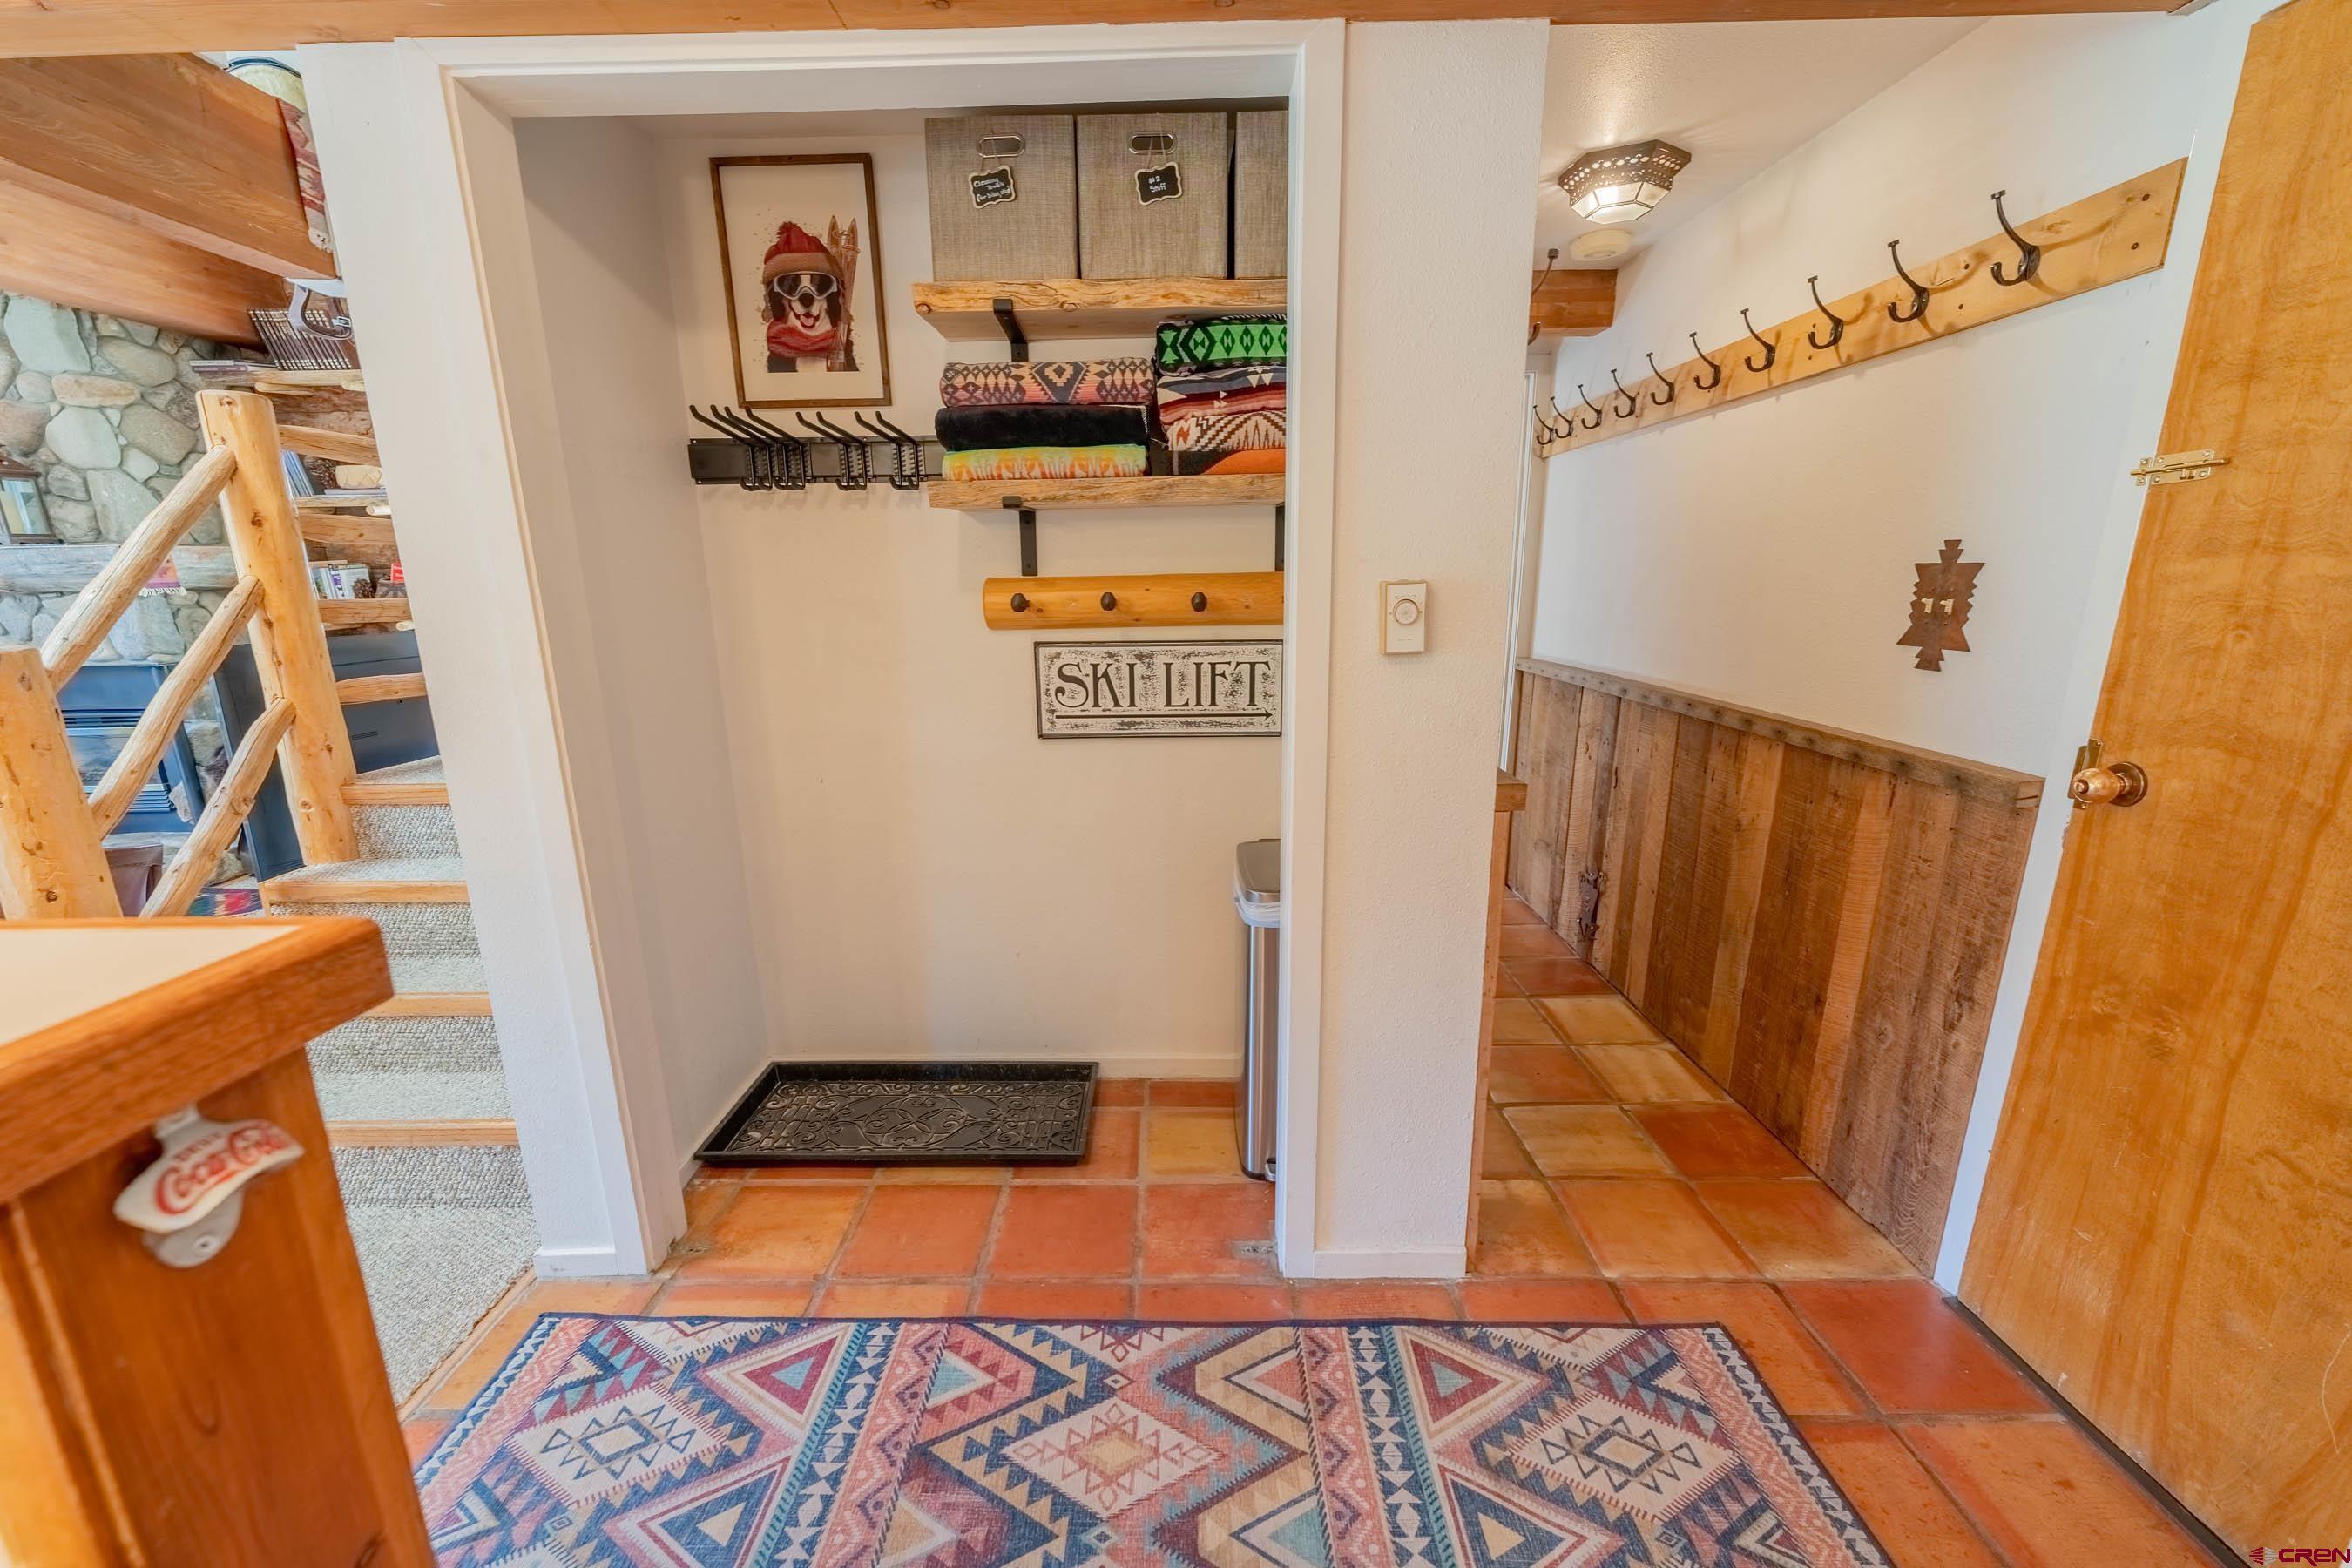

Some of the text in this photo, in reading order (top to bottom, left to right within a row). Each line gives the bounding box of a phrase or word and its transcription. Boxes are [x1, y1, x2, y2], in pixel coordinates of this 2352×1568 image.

[1149, 182, 1166, 193] Stuff
[1055, 661, 1271, 707] SKI LIFT
